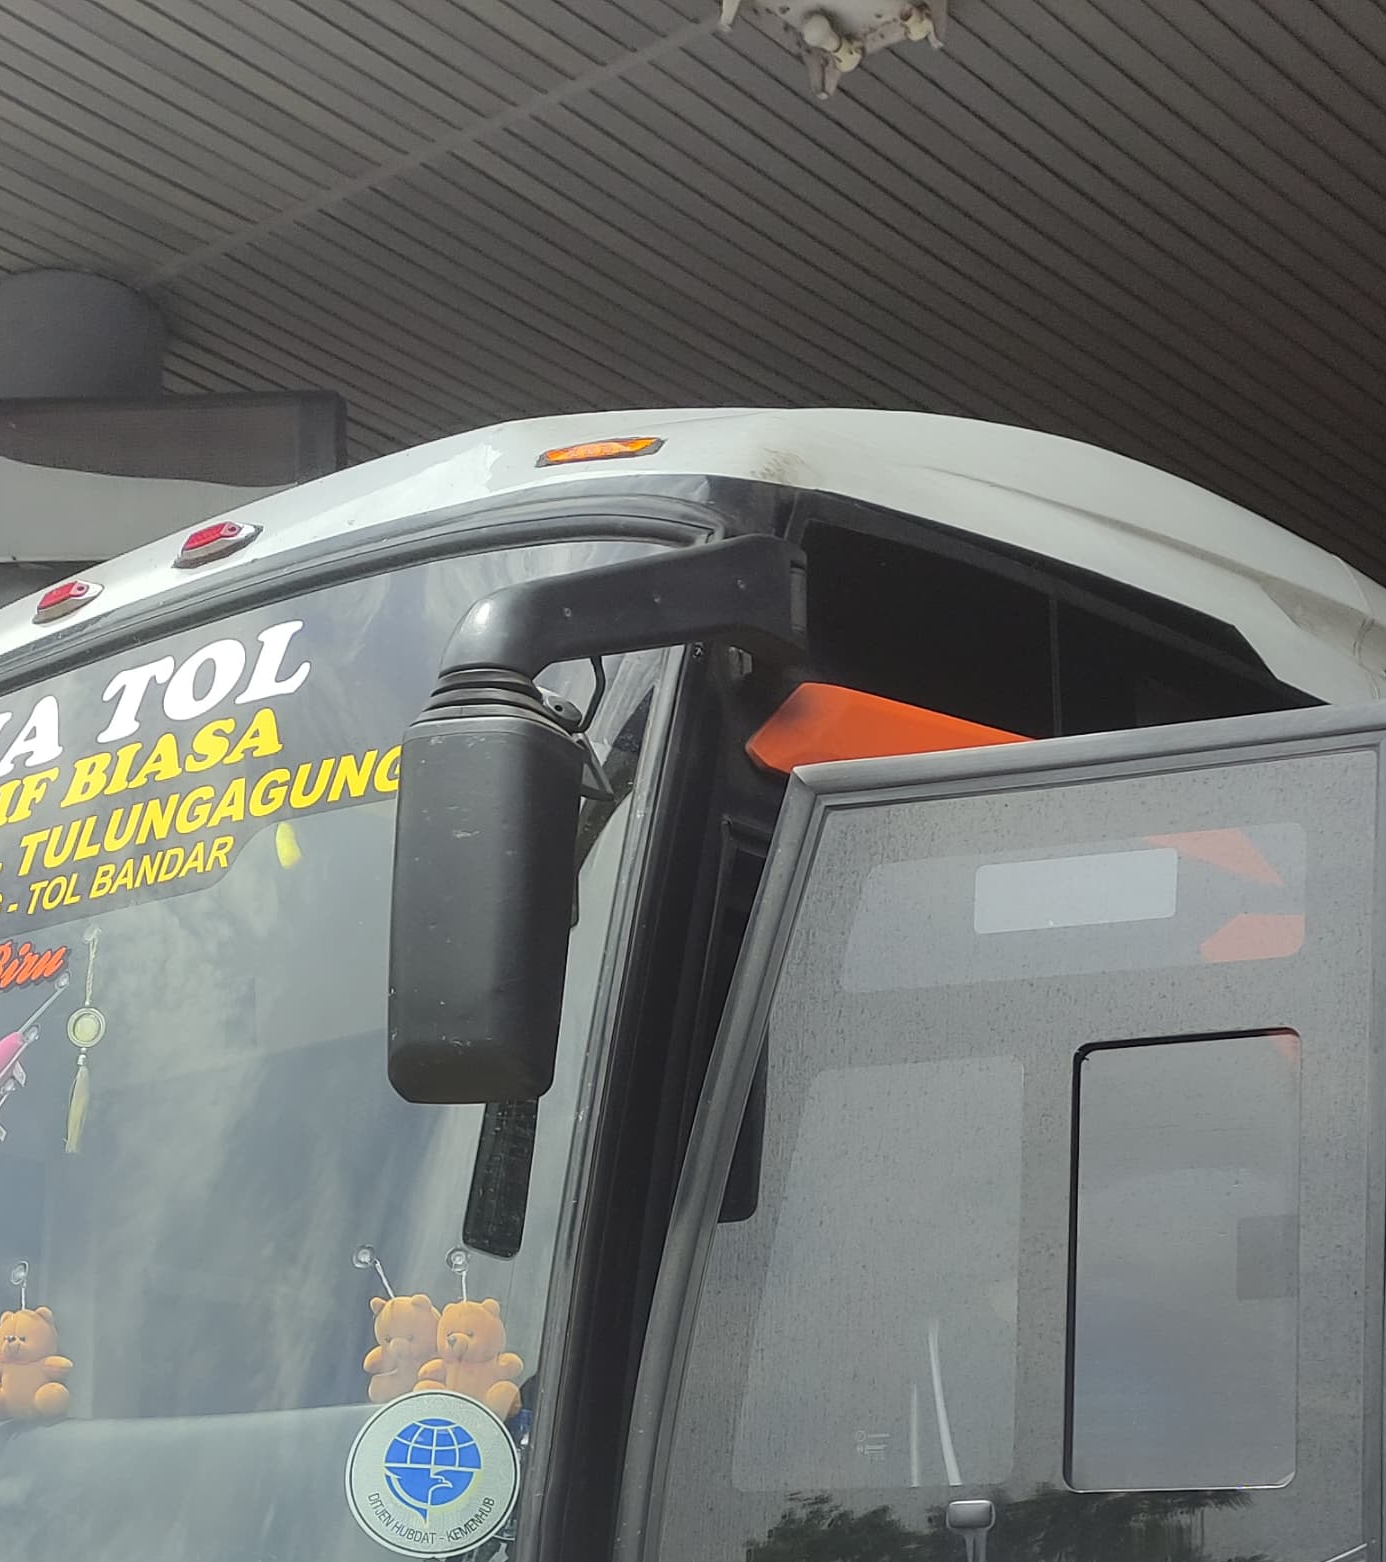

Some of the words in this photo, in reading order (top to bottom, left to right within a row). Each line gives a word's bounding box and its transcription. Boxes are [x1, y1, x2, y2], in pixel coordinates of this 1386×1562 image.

[97, 620, 312, 743] TOL
[60, 707, 284, 808] BIASA
[17, 744, 402, 877] TULUNGAGUNG
[27, 872, 81, 915] TOL
[89, 836, 235, 900] BANDAR
[368, 1493, 393, 1527] DITJEN
[391, 1520, 437, 1545] HUBDAT
[446, 1497, 495, 1543] KEMENHUB
